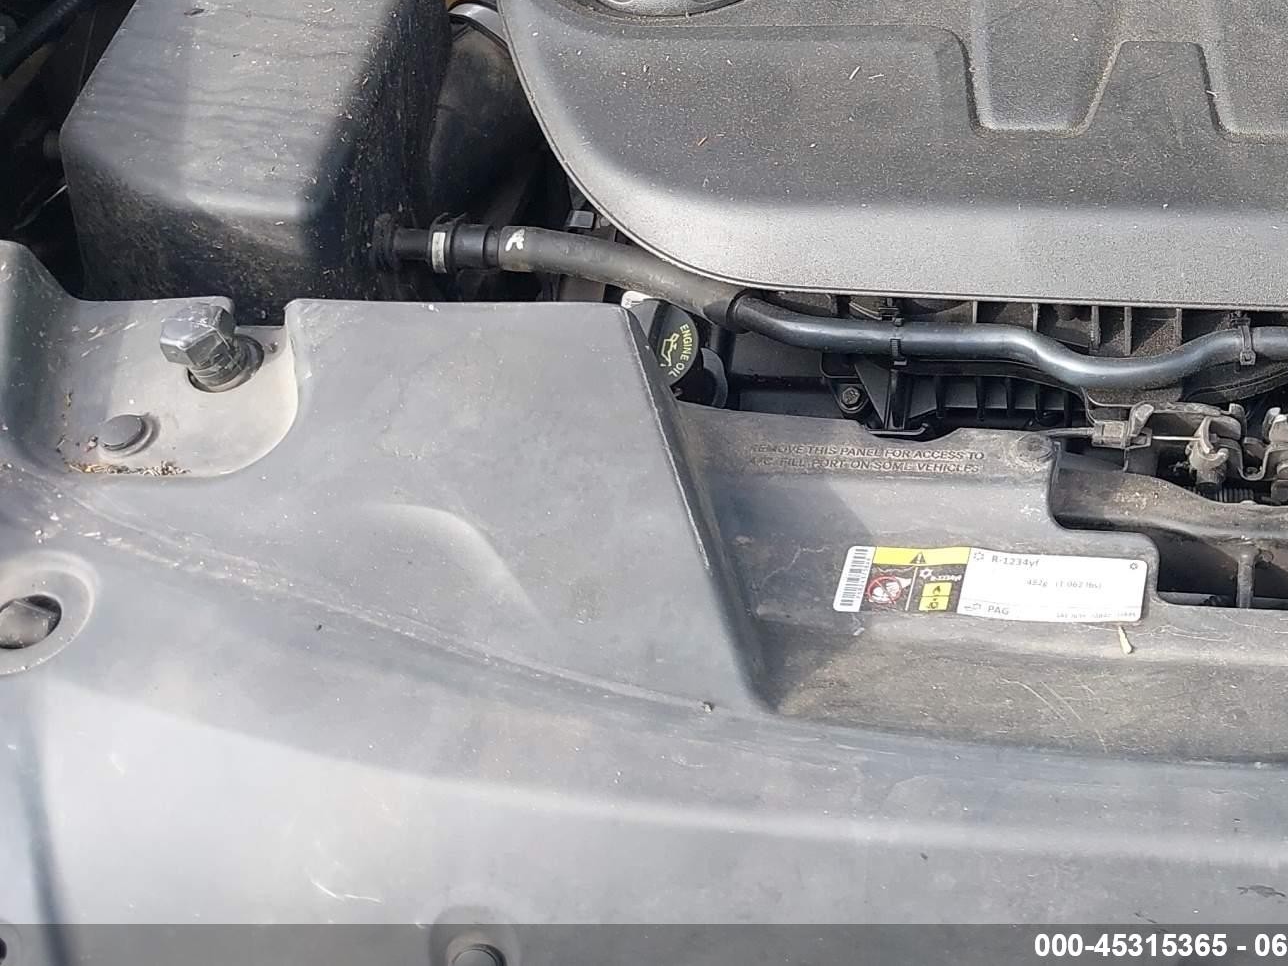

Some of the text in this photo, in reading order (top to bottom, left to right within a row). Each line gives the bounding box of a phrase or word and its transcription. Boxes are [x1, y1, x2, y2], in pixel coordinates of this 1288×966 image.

[668, 323, 692, 377] ENGINE OIL
[751, 444, 985, 460] REMOVE THIS PANEL FOR ACCESS TO
[780, 457, 805, 467] FILL
[811, 458, 846, 468] PORT
[850, 460, 871, 469] ON
[872, 461, 913, 471] SOME
[917, 462, 980, 473] VEHICLES
[991, 554, 1041, 568] R-1234yf
[987, 604, 1010, 616] PAG
